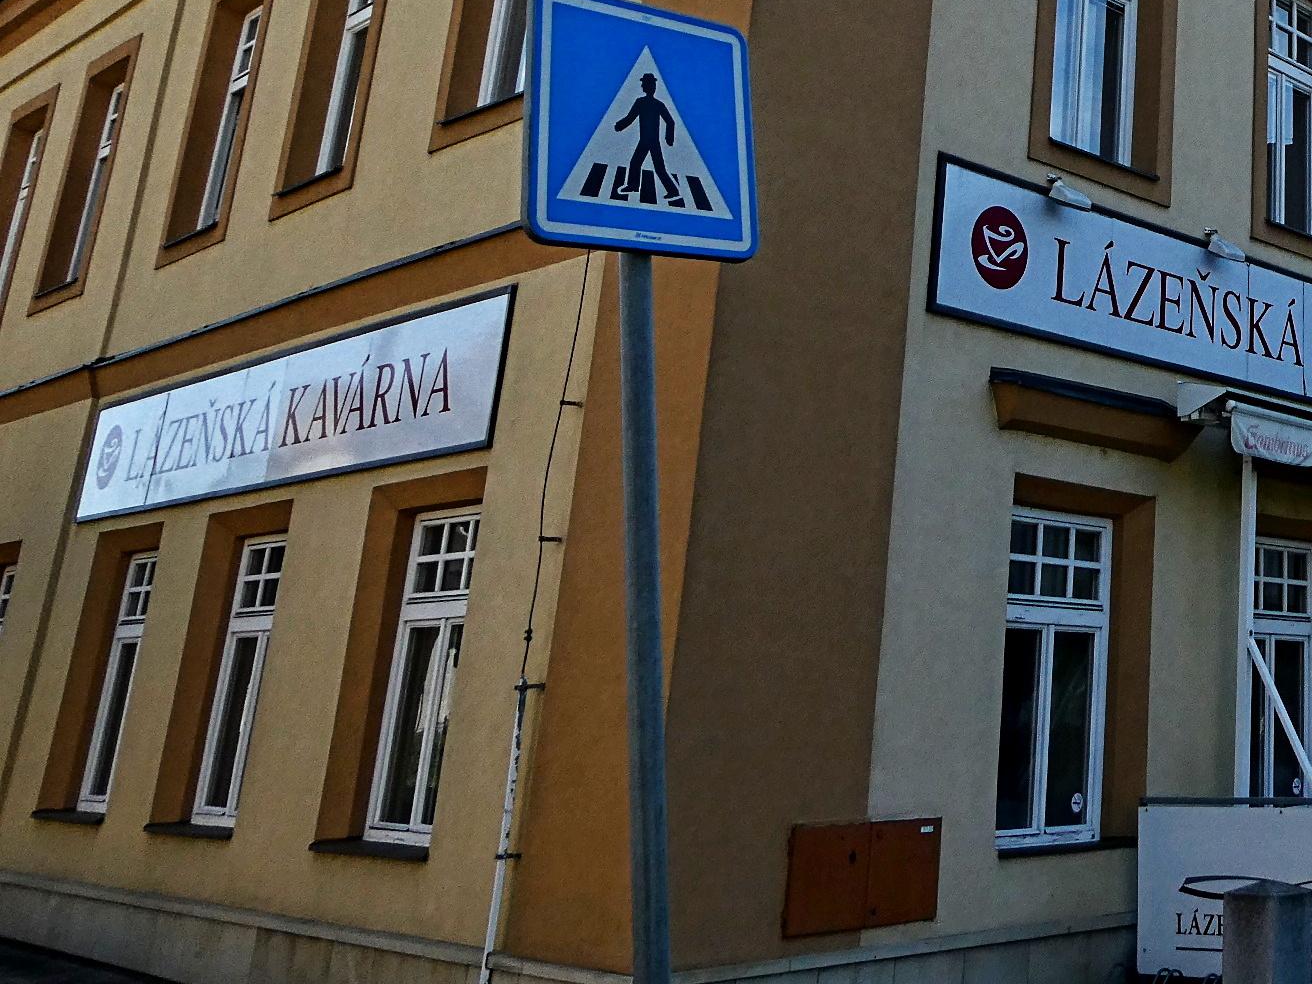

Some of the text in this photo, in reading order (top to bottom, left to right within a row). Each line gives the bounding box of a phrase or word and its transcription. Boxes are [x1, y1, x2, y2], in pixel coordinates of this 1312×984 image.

[1051, 236, 1304, 367] LÁZEŇSKÁ
[125, 347, 452, 482] LÁZEŇSKÁ KAVÁRNA
